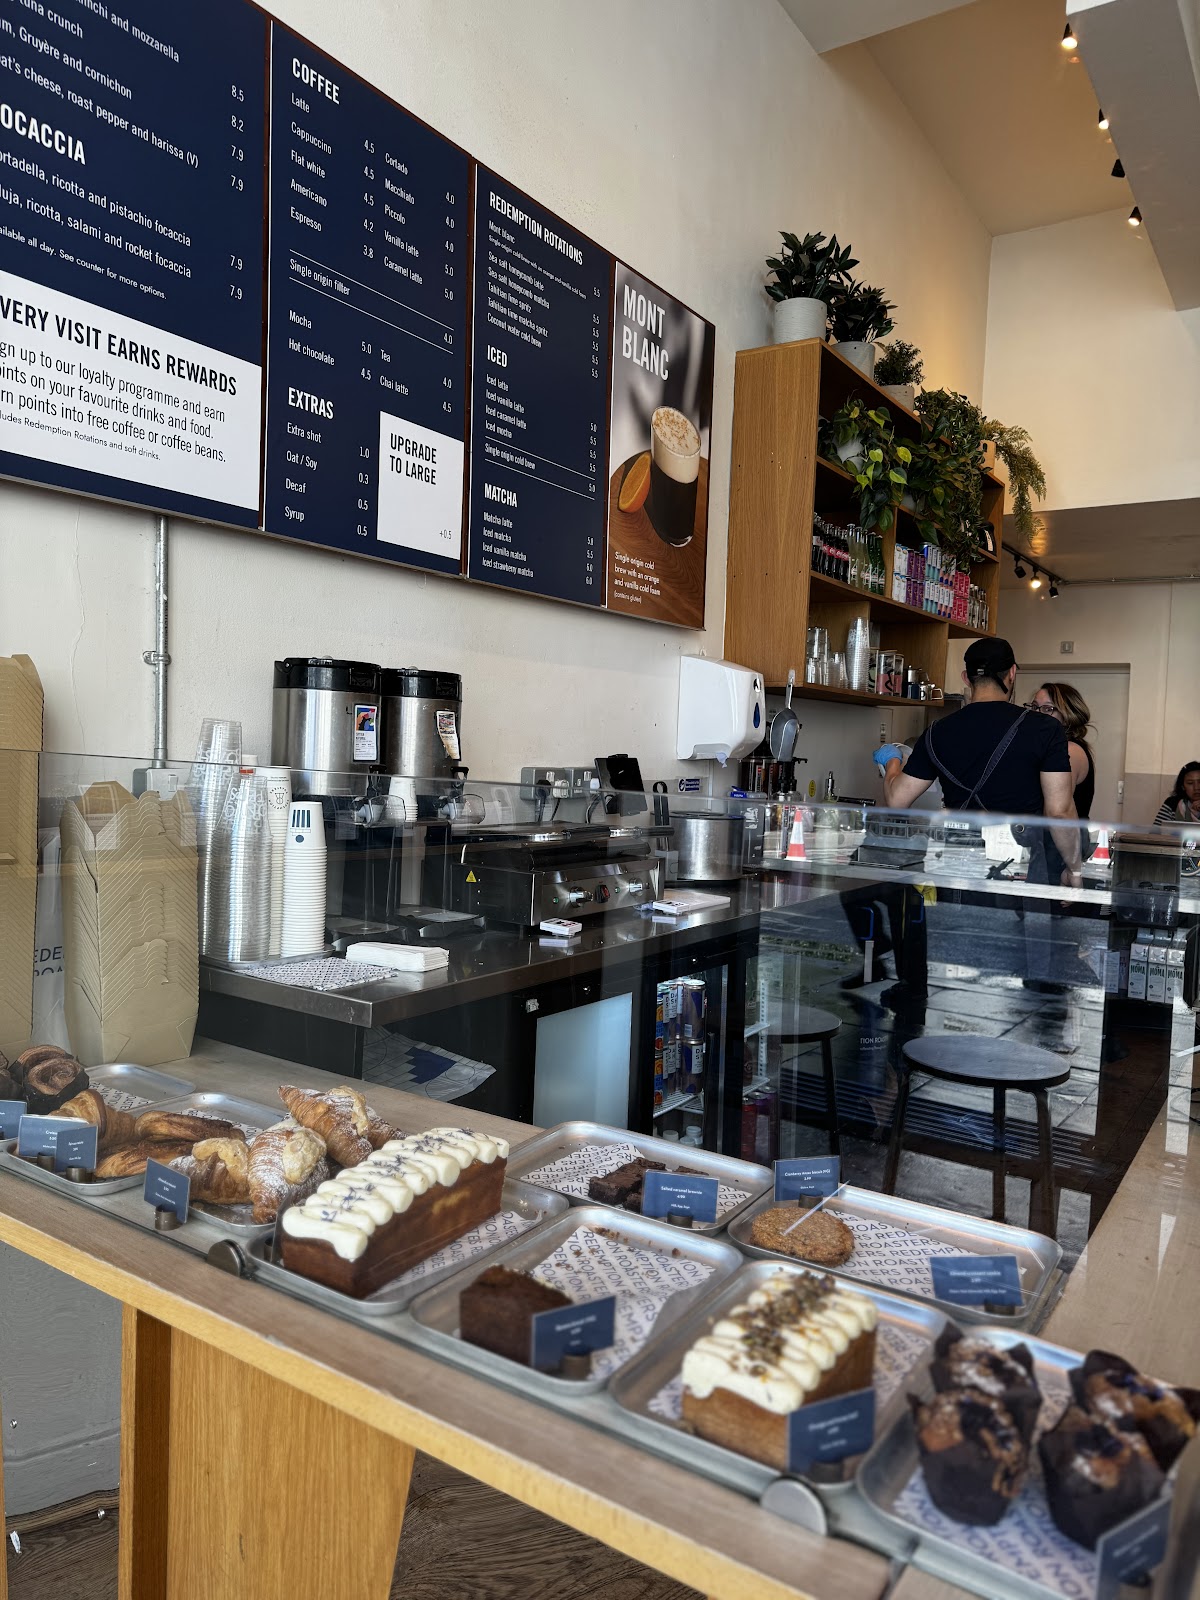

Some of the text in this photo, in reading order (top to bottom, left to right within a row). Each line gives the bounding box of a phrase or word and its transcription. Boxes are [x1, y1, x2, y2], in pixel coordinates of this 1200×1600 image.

[47, 9, 82, 38] crunch
[110, 13, 179, 62] and mozzarella
[19, 26, 131, 99] Gruyère and cornichon
[292, 57, 339, 104] COFFEE
[231, 84, 244, 102] 8.5
[291, 92, 309, 113] Latte
[24, 67, 64, 99] cheese,
[67, 90, 93, 112] roast
[96, 105, 129, 130] pepper
[131, 124, 148, 141] and
[151, 131, 183, 160] harissa
[186, 151, 198, 168] (V)
[231, 115, 243, 132] 8.2
[291, 121, 331, 154] Cappuccino
[363, 139, 374, 153] 4.5
[231, 144, 243, 161] 7.9
[291, 149, 325, 178] Flat white
[385, 152, 408, 175] Cortado
[230, 174, 243, 191] 7.9
[363, 165, 374, 180] 4.5
[290, 178, 327, 207] Americano
[363, 192, 374, 206] 4.5
[384, 177, 414, 204] Macchiato
[445, 191, 454, 204] 4.0
[52, 173, 84, 198] ricotta
[88, 192, 106, 208] and
[109, 201, 152, 229] pistachio
[154, 219, 190, 246] focaccia
[290, 206, 321, 231] Espresso
[384, 203, 405, 224] Piccolo
[363, 218, 373, 232] 4.2
[489, 191, 582, 265] REDEMPTION ROTATIONS
[26, 197, 191, 278] ricotta, salami and rocket focaccia
[384, 229, 419, 257] Vanilla latte
[230, 254, 242, 270] 7.9
[362, 244, 373, 258] 3.8
[27, 236, 37, 247] all
[39, 241, 56, 256] day.
[59, 248, 74, 262] See
[76, 258, 104, 274] counter
[106, 267, 117, 279] for
[119, 275, 137, 287] more
[139, 283, 166, 299] options.
[289, 258, 350, 295] Single origin filter
[383, 255, 422, 284] Caramel latte
[444, 263, 453, 276] 5.0
[229, 284, 242, 299] 7.9
[444, 288, 453, 300] 5.0
[289, 309, 311, 329] Mocha
[623, 284, 665, 338] MONT
[361, 340, 371, 354] 5.0
[443, 332, 452, 344] 4.0
[55, 314, 101, 350] VISIT
[107, 333, 160, 370] EARNS
[166, 353, 236, 396] REWARDS
[288, 337, 334, 365] Hot chocolate
[380, 348, 390, 362] Tea
[487, 344, 507, 367] ICED
[622, 324, 668, 380] BLANC
[20, 347, 36, 366] up
[39, 350, 52, 368] to
[55, 359, 75, 375] our
[79, 362, 115, 390] loyalty
[118, 379, 179, 408] programme
[182, 399, 200, 414] and
[204, 406, 224, 422] earn
[360, 367, 371, 380] 4.5
[379, 375, 408, 395] Chai latte
[0, 361, 213, 438] ints on your favourite drinks and food.
[288, 386, 333, 419] EXTRAS
[18, 394, 56, 416] points
[61, 402, 83, 423] into
[86, 410, 108, 430] free
[112, 420, 145, 440] coffee
[148, 431, 158, 443] or
[161, 434, 191, 453] coffee
[194, 444, 225, 462] beans.
[24, 417, 71, 437] Redemption
[74, 430, 107, 446] Rotations
[108, 441, 122, 450] and
[124, 445, 136, 454] soft
[138, 447, 160, 461] drinks.
[287, 421, 321, 443] Extra shot
[359, 446, 369, 458] 1.0
[390, 432, 436, 464] UPGRADE
[286, 450, 317, 470] Oat Soy
[389, 454, 436, 485] TO LARGE
[285, 477, 306, 493] Decaf
[358, 472, 368, 484] 0.3
[357, 498, 368, 510] 0.5
[484, 482, 517, 507] MATCHA
[284, 505, 304, 522] Syrup
[356, 524, 367, 536] 0.5
[439, 529, 451, 539] +0.5
